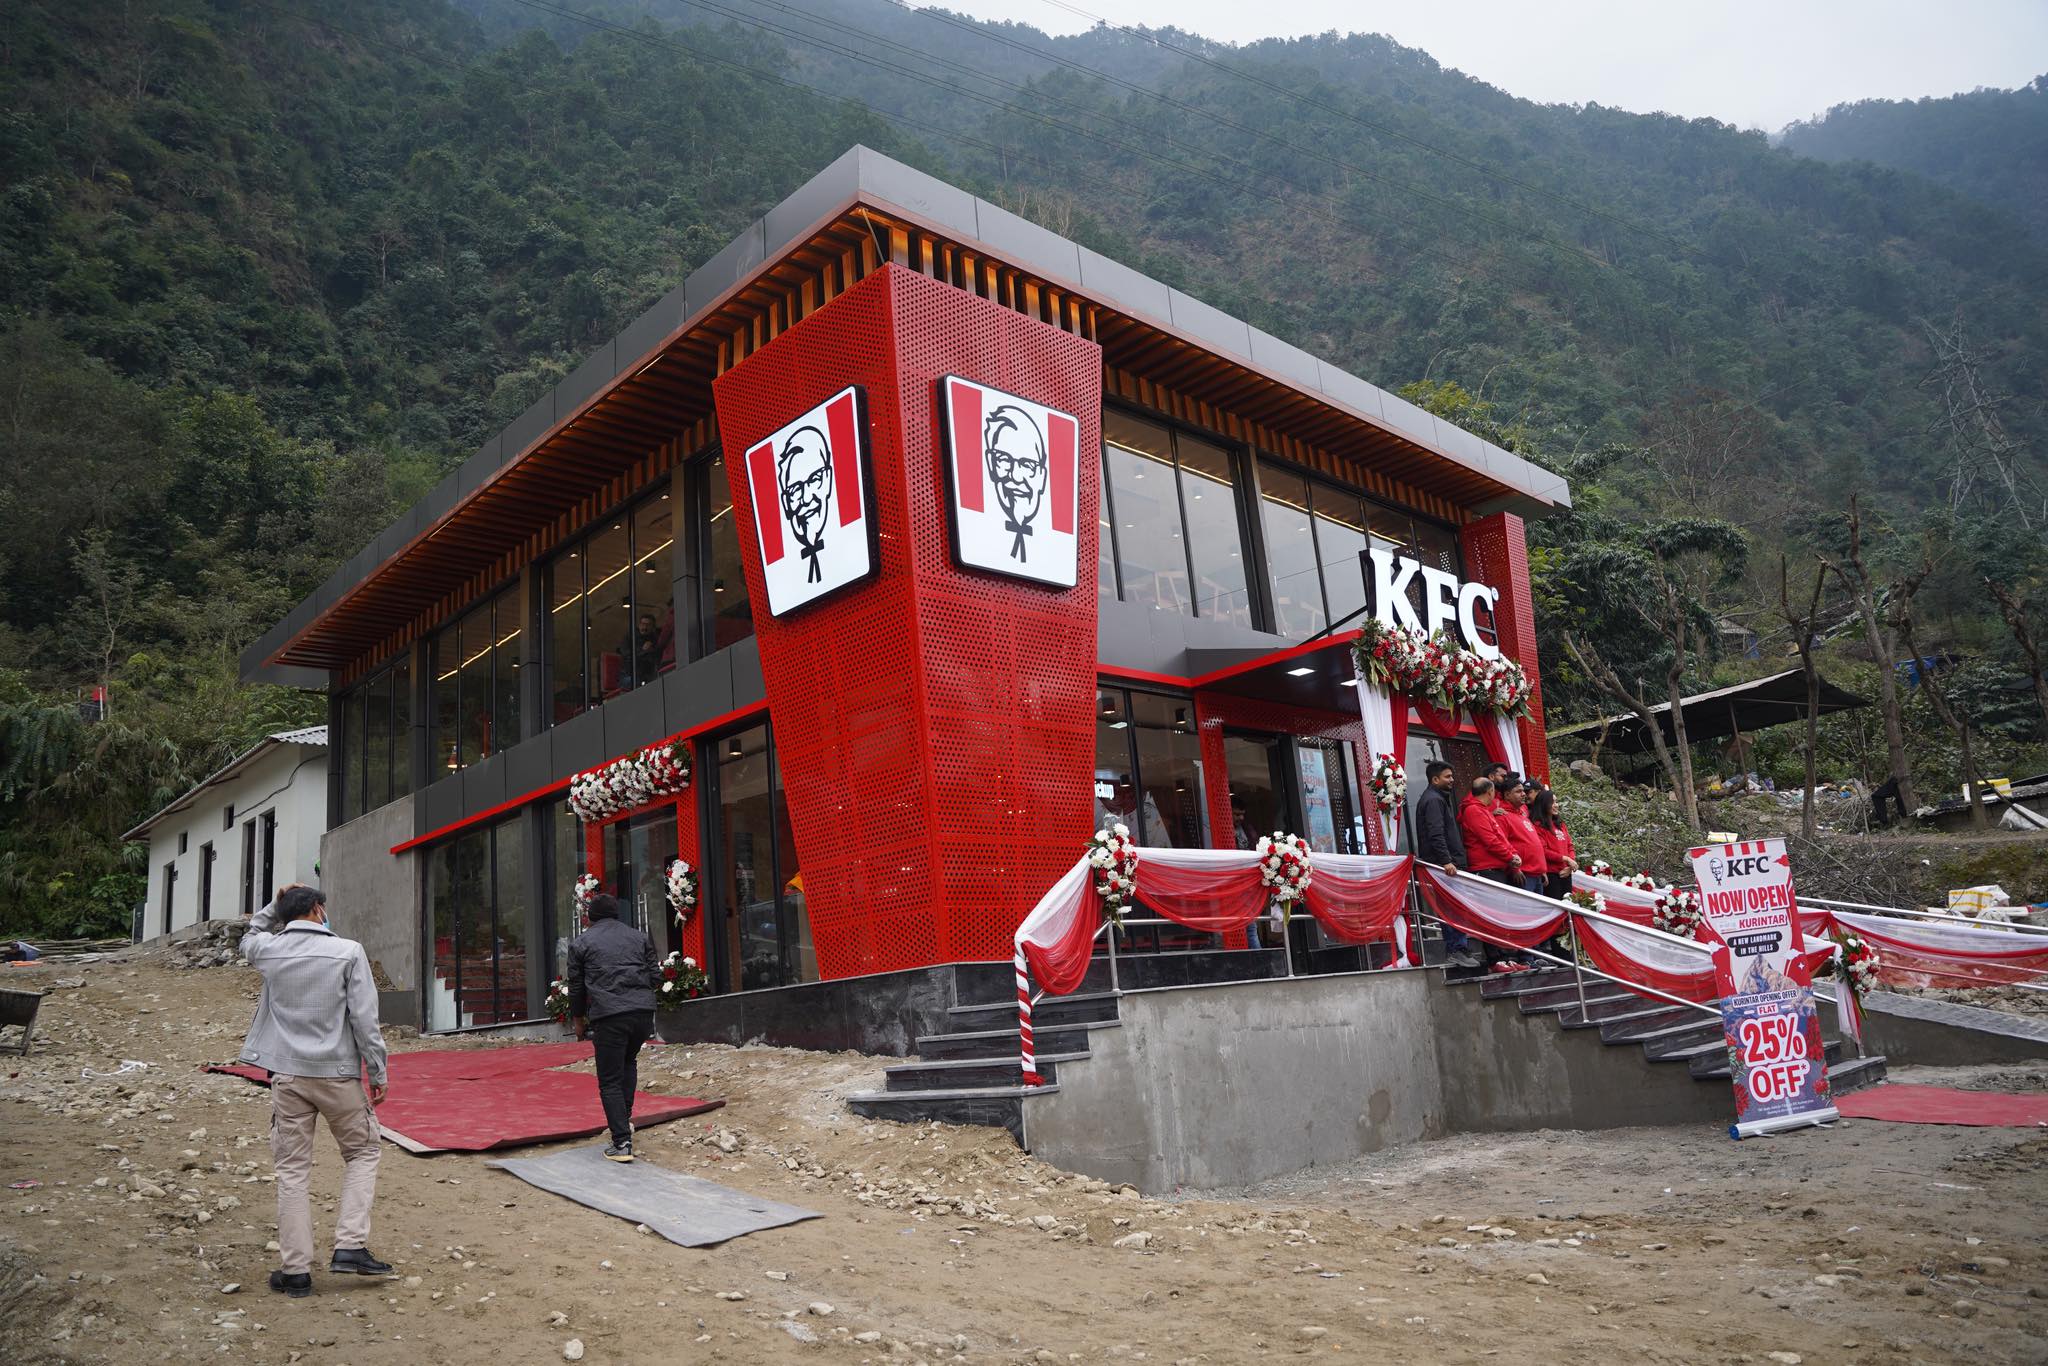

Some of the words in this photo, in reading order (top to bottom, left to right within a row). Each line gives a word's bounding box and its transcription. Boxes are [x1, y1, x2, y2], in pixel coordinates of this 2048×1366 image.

[1727, 856, 1770, 877] KFC
[1707, 889, 1746, 917] NOW
[1747, 884, 1789, 912] OPEN
[1739, 914, 1787, 929] KURINTAR
[1733, 937, 1738, 946] A
[1738, 936, 1749, 945] NEW
[1750, 933, 1778, 943] LANDMARK
[1740, 947, 1747, 955] IN
[1748, 946, 1757, 954] THE
[1758, 944, 1774, 953] HILLS
[1734, 995, 1760, 1007] KURINTAR
[1760, 992, 1782, 1003] OPENING
[1782, 989, 1797, 999] OFFER
[1759, 1004, 1776, 1015] FLAT
[1743, 1017, 1803, 1062] 25%
